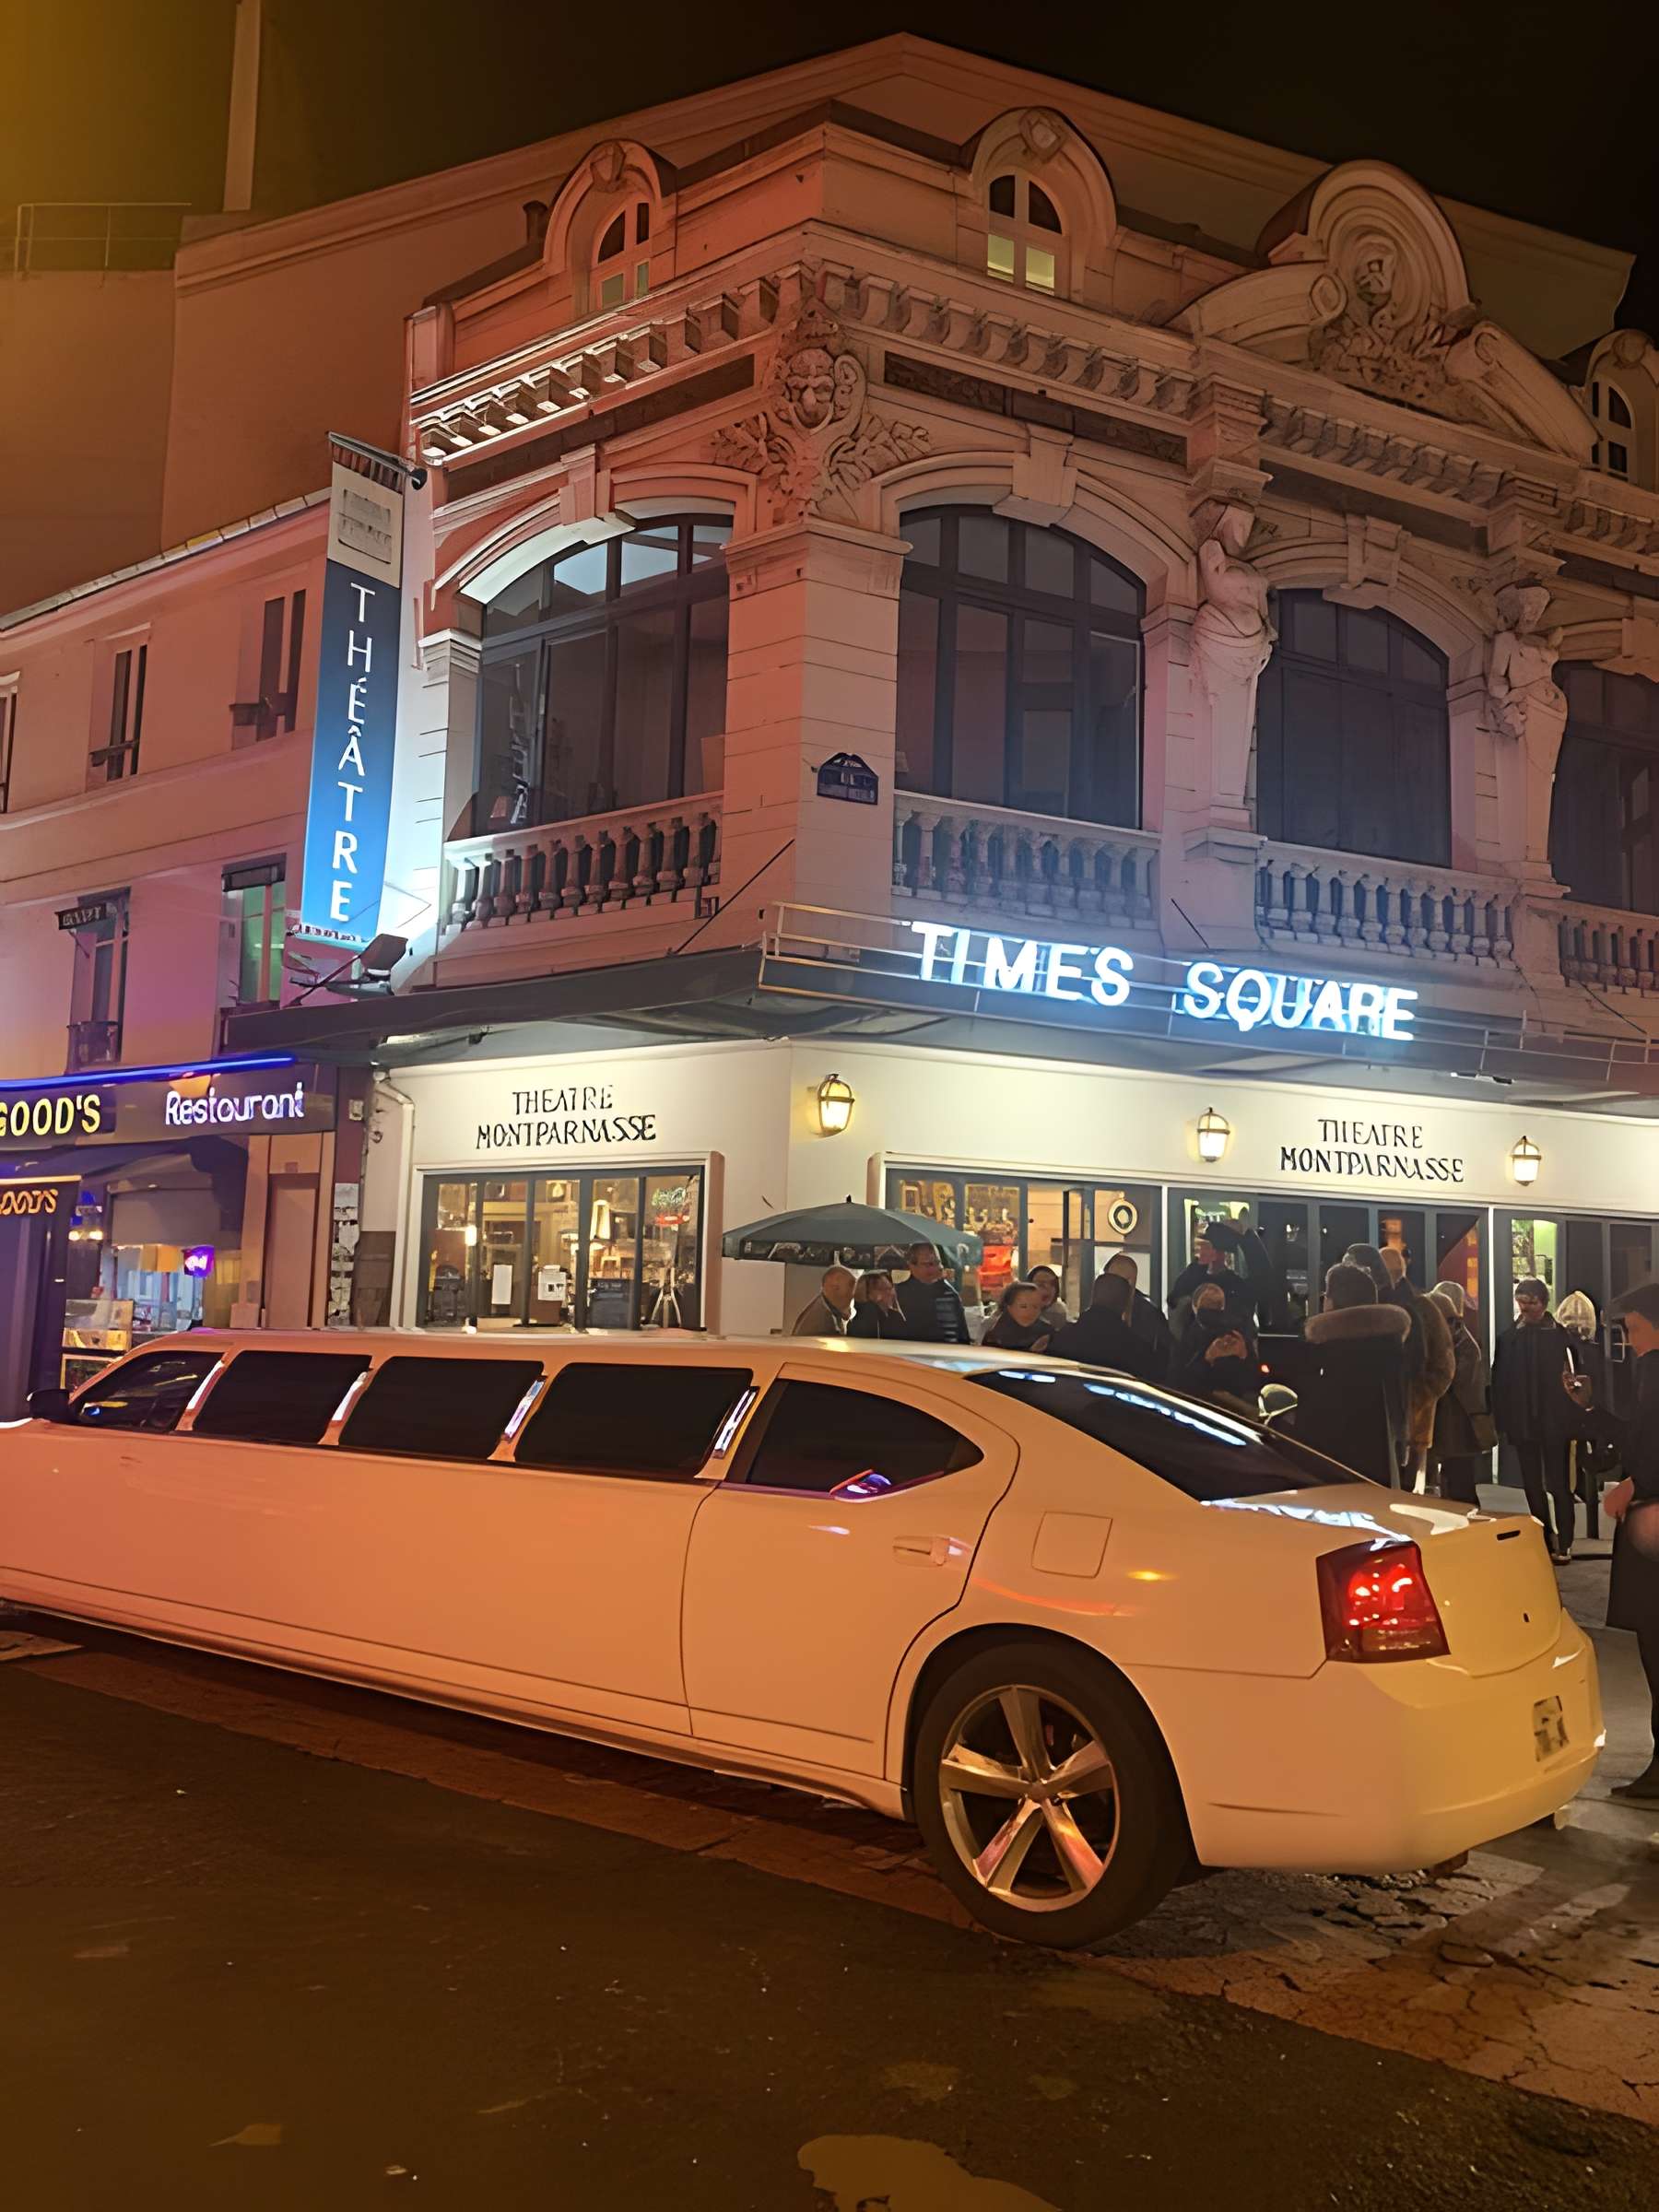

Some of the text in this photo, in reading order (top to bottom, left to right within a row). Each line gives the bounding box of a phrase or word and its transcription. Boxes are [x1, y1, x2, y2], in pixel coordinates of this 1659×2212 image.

[329, 582, 376, 923] THÉÂTRE
[912, 921, 1418, 1041] TIMES SQUARE
[165, 1081, 305, 1125] Restaurant
[512, 1085, 614, 1115] THEATRE
[476, 1114, 656, 1149] MONTPARNASSE
[1317, 1119, 1423, 1149] THEATRE
[1280, 1146, 1465, 1183] MONTPARNASSE
